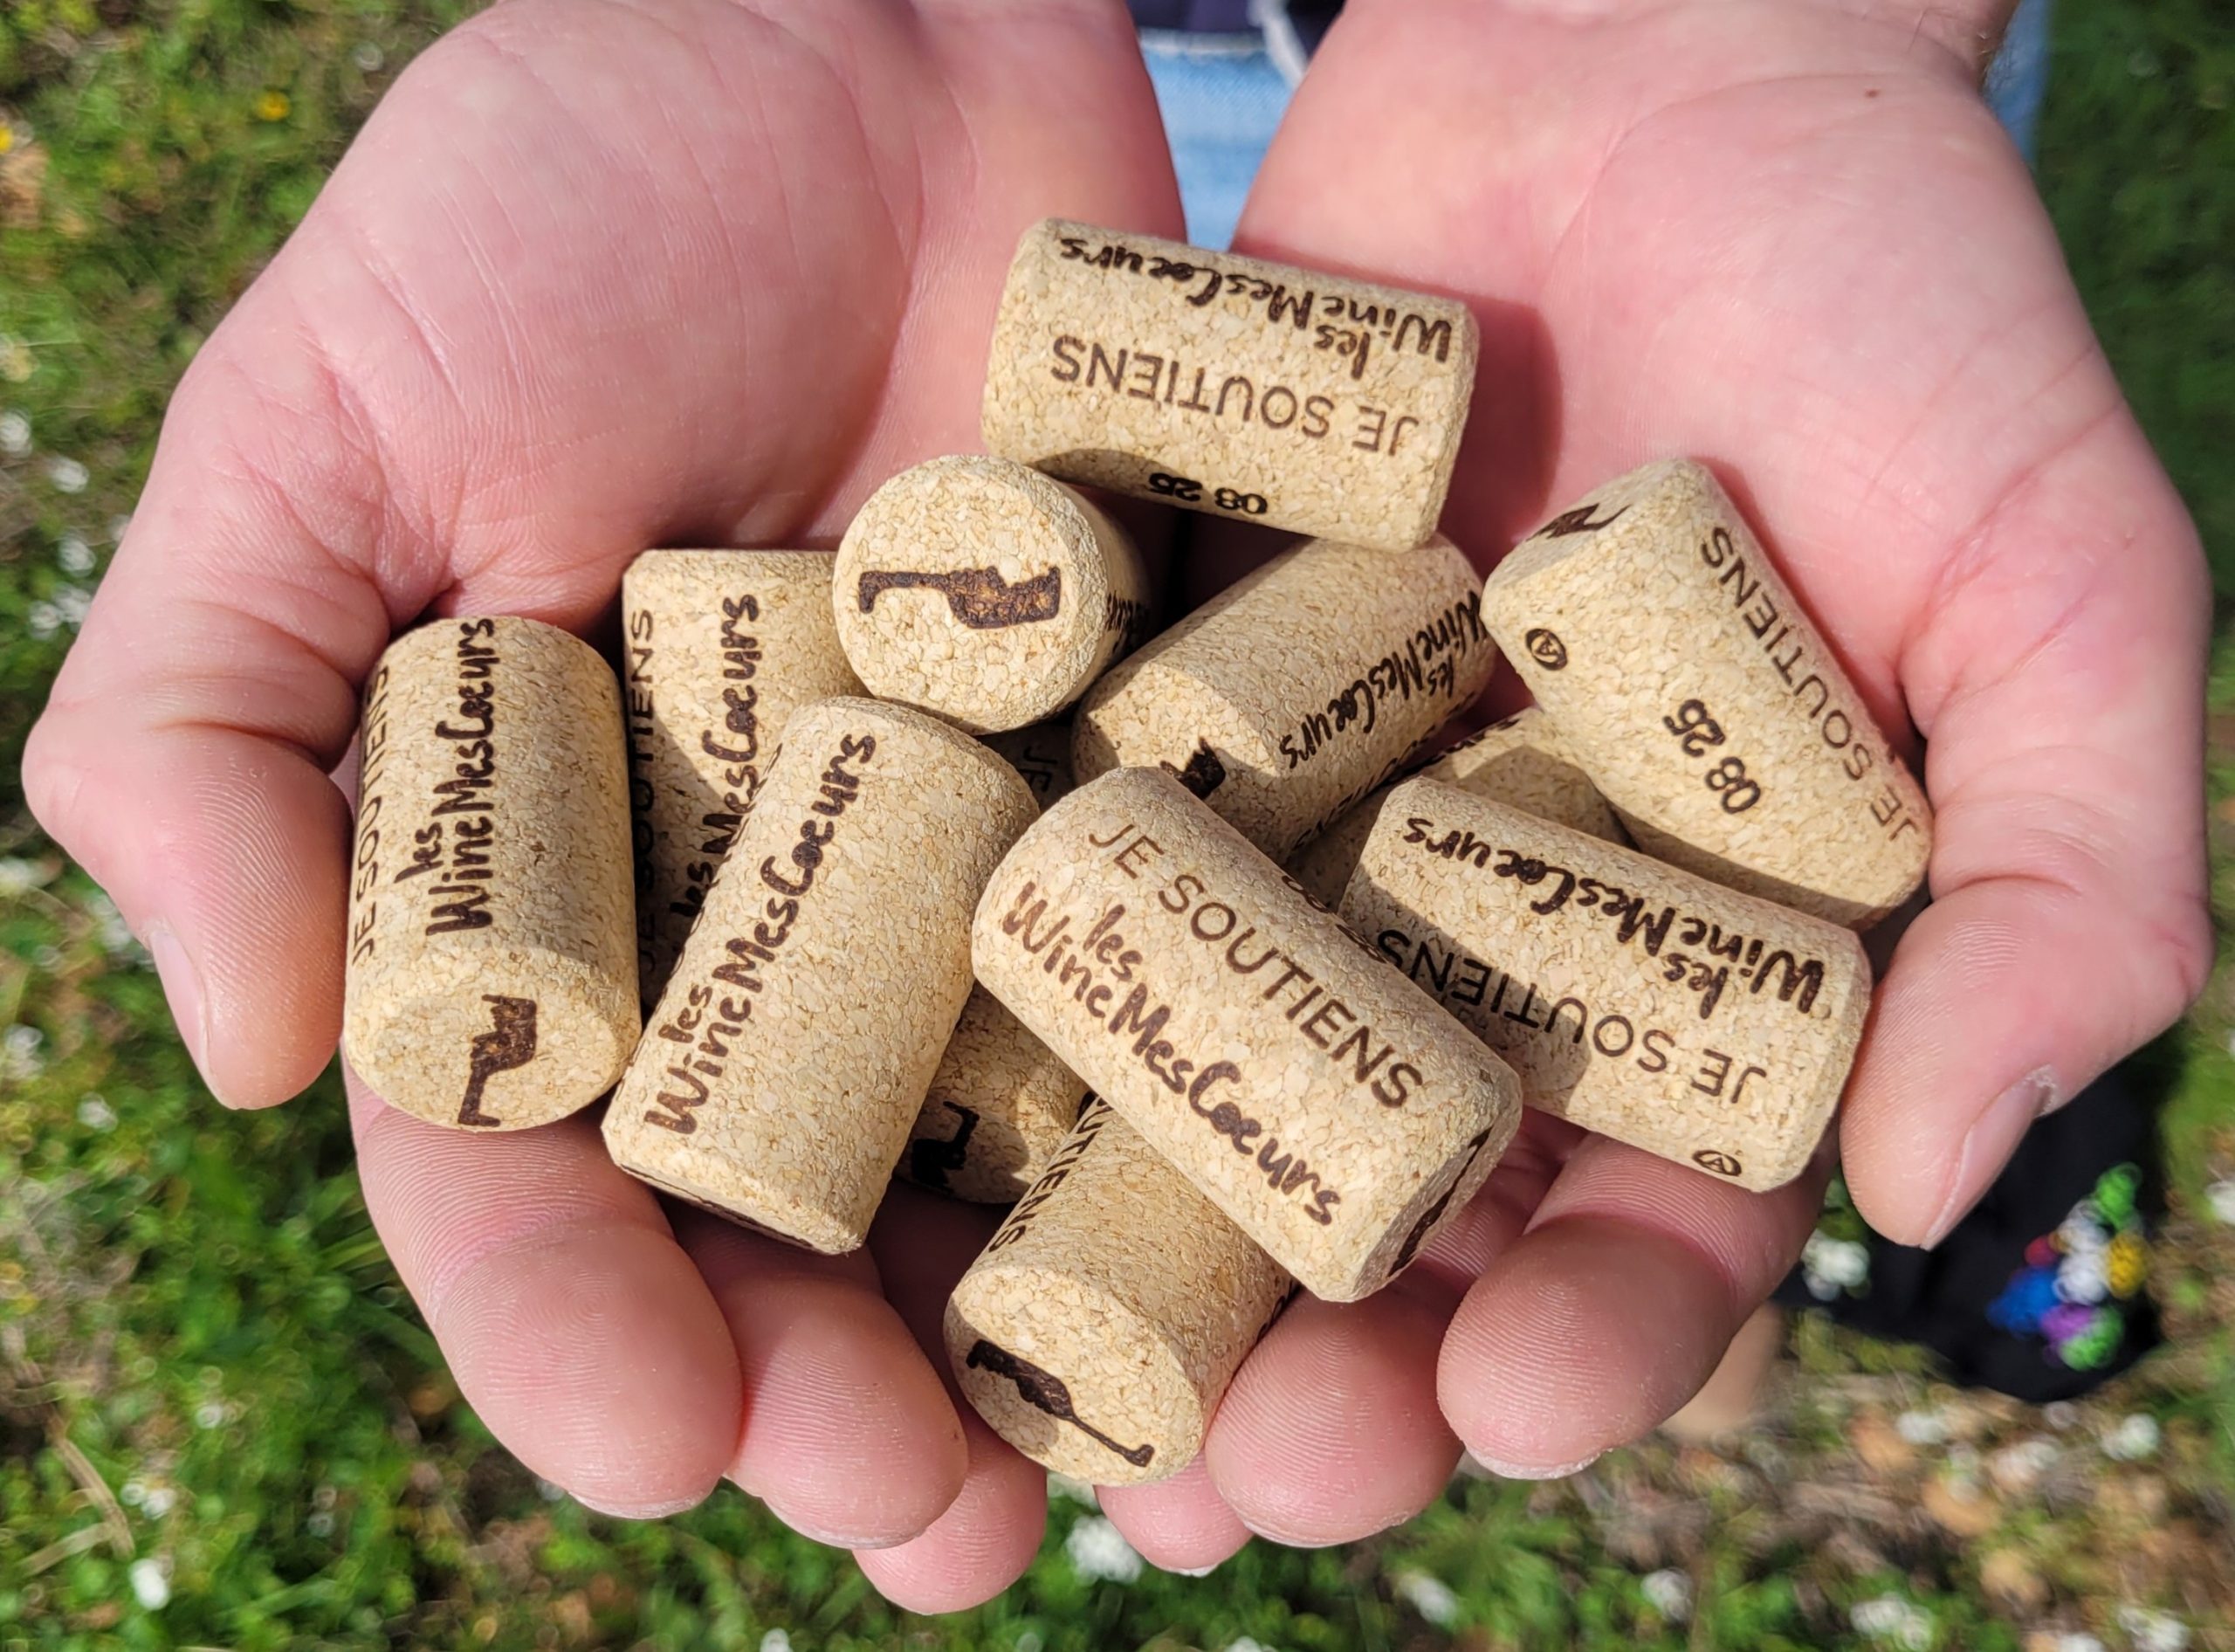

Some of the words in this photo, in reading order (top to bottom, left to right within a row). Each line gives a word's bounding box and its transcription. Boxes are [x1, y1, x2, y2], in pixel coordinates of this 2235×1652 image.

[1313, 323, 1371, 381] les
[1050, 334, 1336, 438] SOUTIENS
[1351, 403, 1420, 457] JE
[1214, 486, 1269, 515] 08
[1701, 526, 1874, 782] SOUTIENS
[1704, 756, 1762, 815] 08
[1869, 786, 1920, 842] JE
[395, 821, 443, 885] les
[1083, 904, 1145, 984] les
[1089, 823, 1165, 879] JE
[1158, 873, 1424, 1109] SOUTIENS
[657, 984, 714, 1044] les
[1377, 927, 1676, 1074] SOUTIENS
[1662, 951, 1731, 1020] les
[1690, 1048, 1768, 1105] JE
